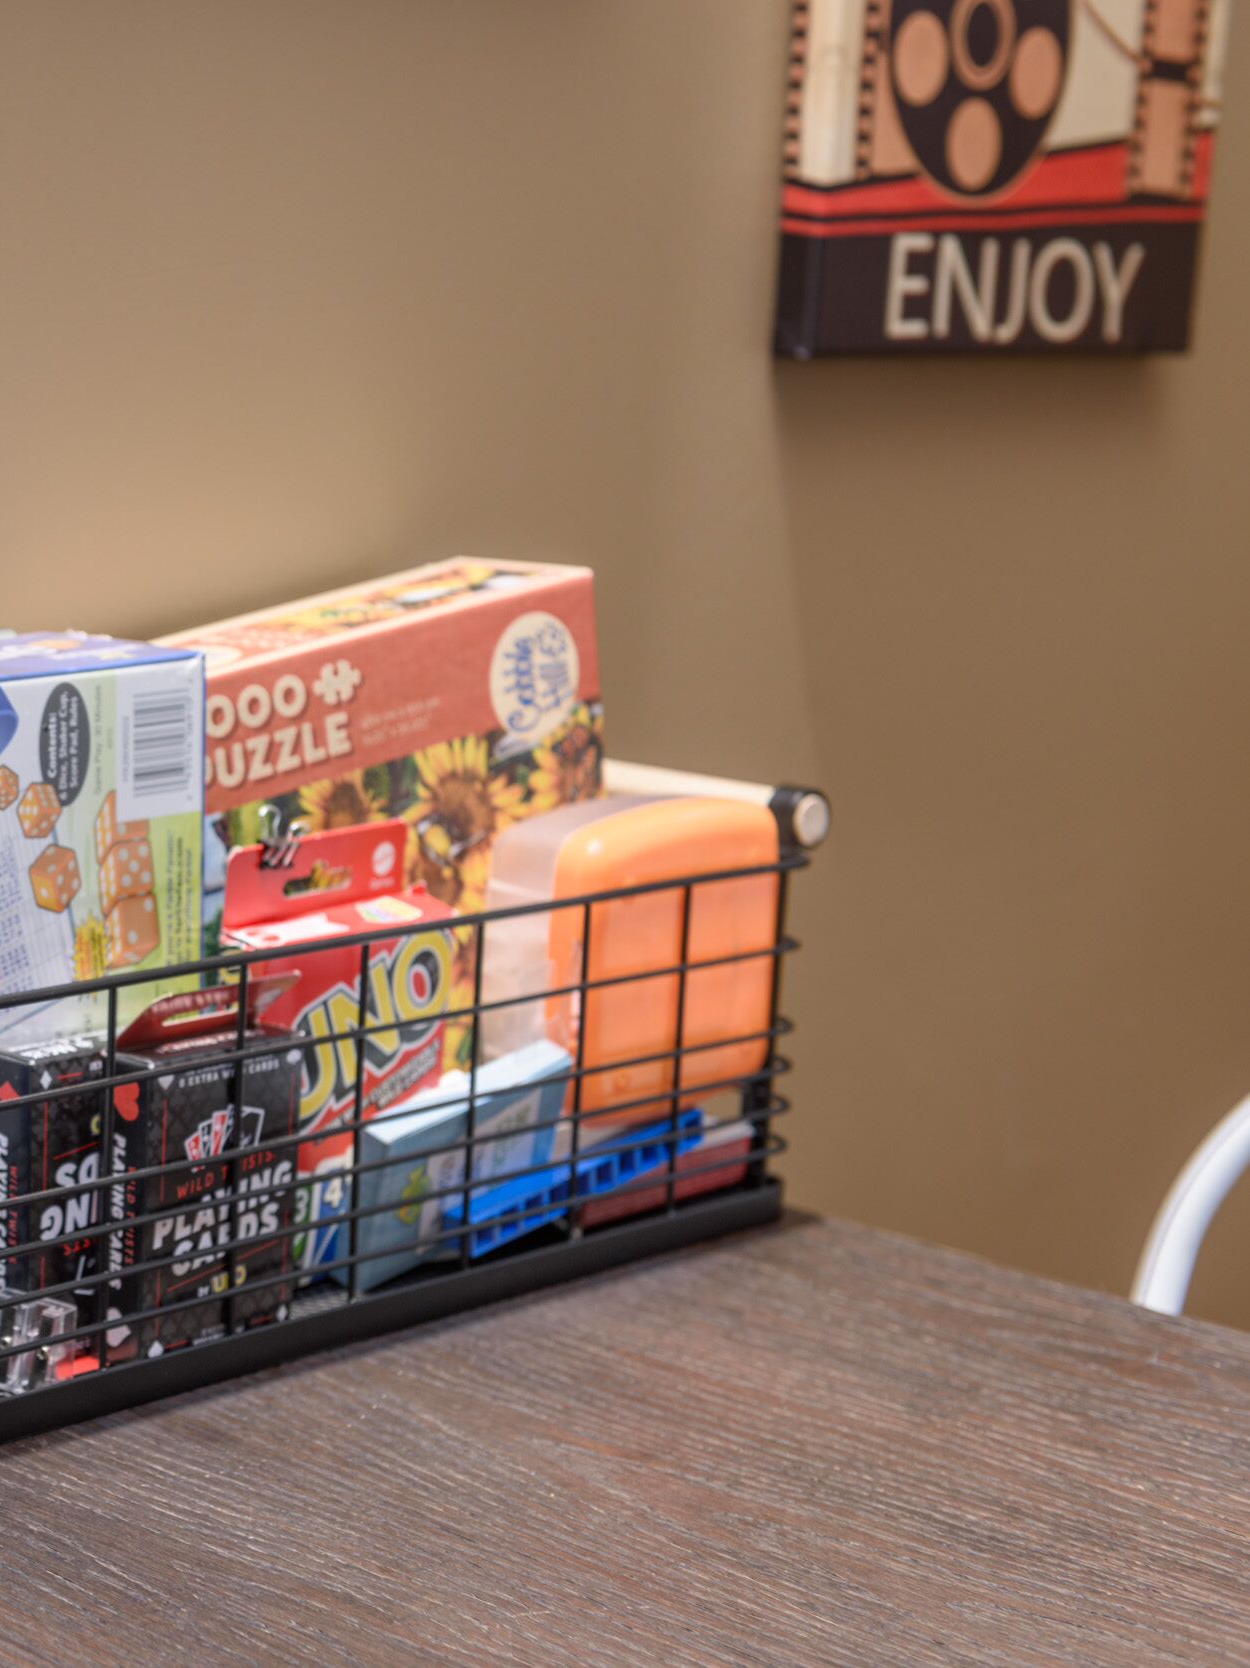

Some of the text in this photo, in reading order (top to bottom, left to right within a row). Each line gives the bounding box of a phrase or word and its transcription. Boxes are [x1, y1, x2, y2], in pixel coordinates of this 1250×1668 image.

[883, 231, 1146, 345] ENJOY
[206, 673, 308, 740] 000
[177, 1172, 215, 1200] WILD
[323, 1174, 344, 1209] 4
